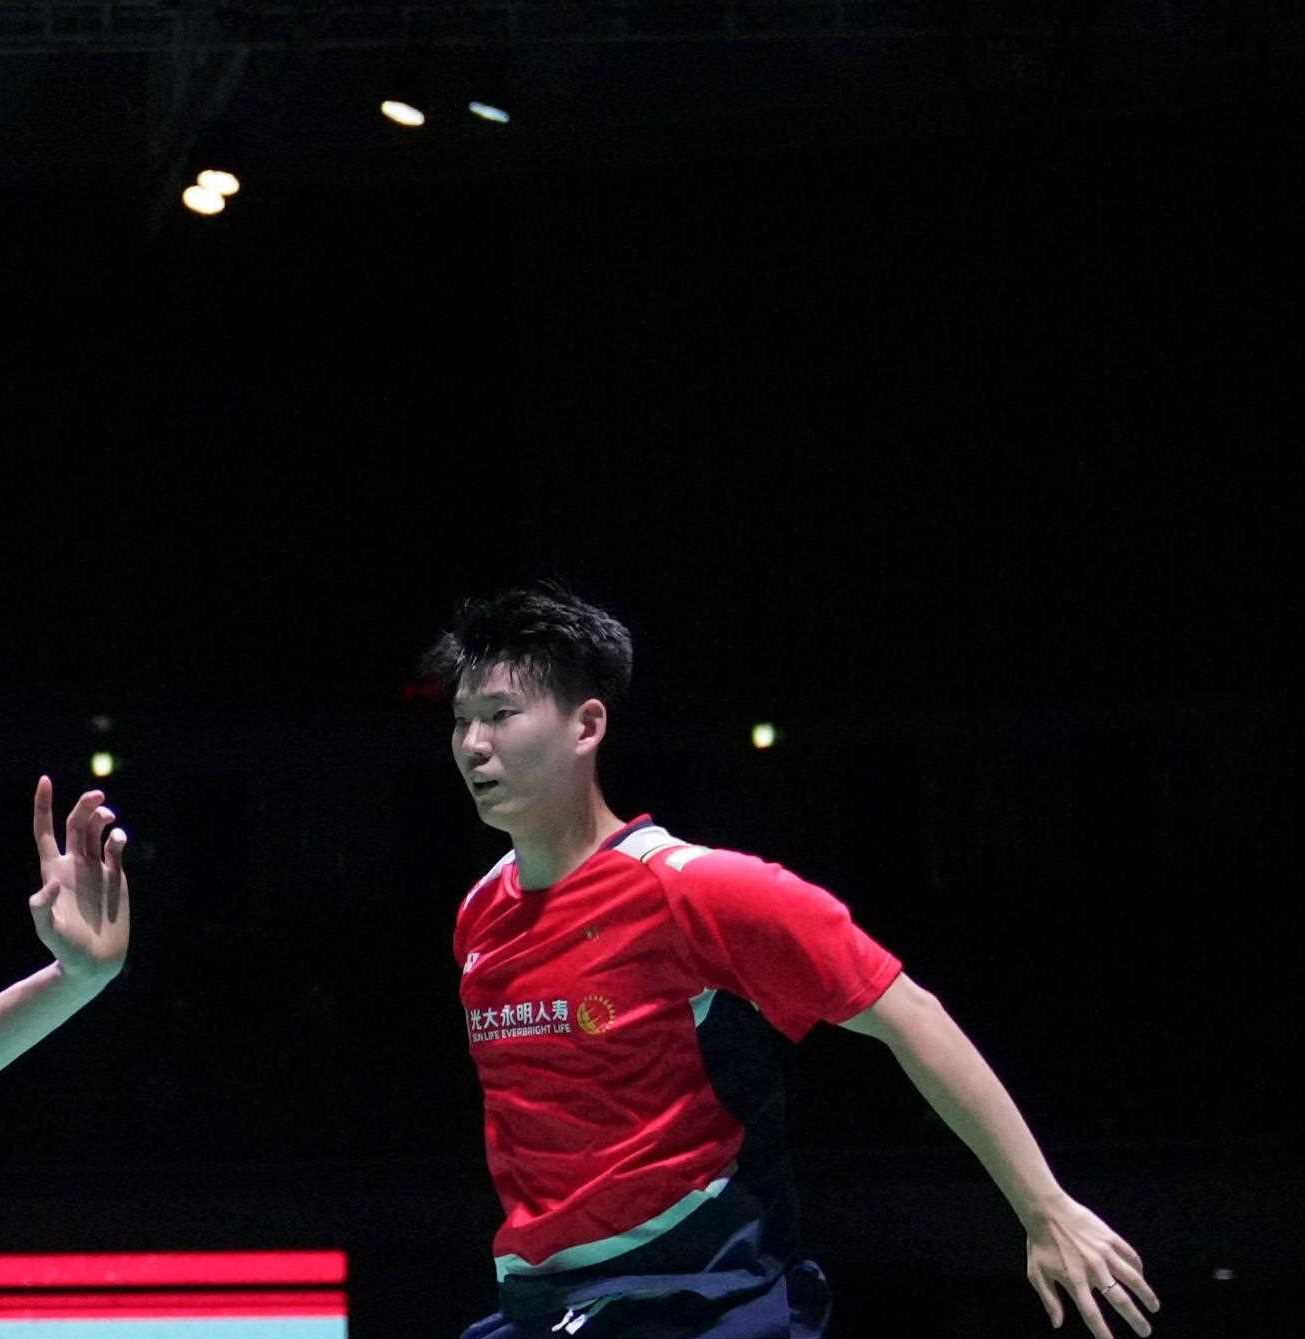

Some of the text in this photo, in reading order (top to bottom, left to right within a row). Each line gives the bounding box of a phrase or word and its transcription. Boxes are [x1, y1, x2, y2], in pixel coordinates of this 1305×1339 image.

[470, 1000, 568, 1030] 光大永明人寿
[501, 1024, 551, 1039] EVERBRIGHT
[553, 1023, 571, 1034] LIFE
